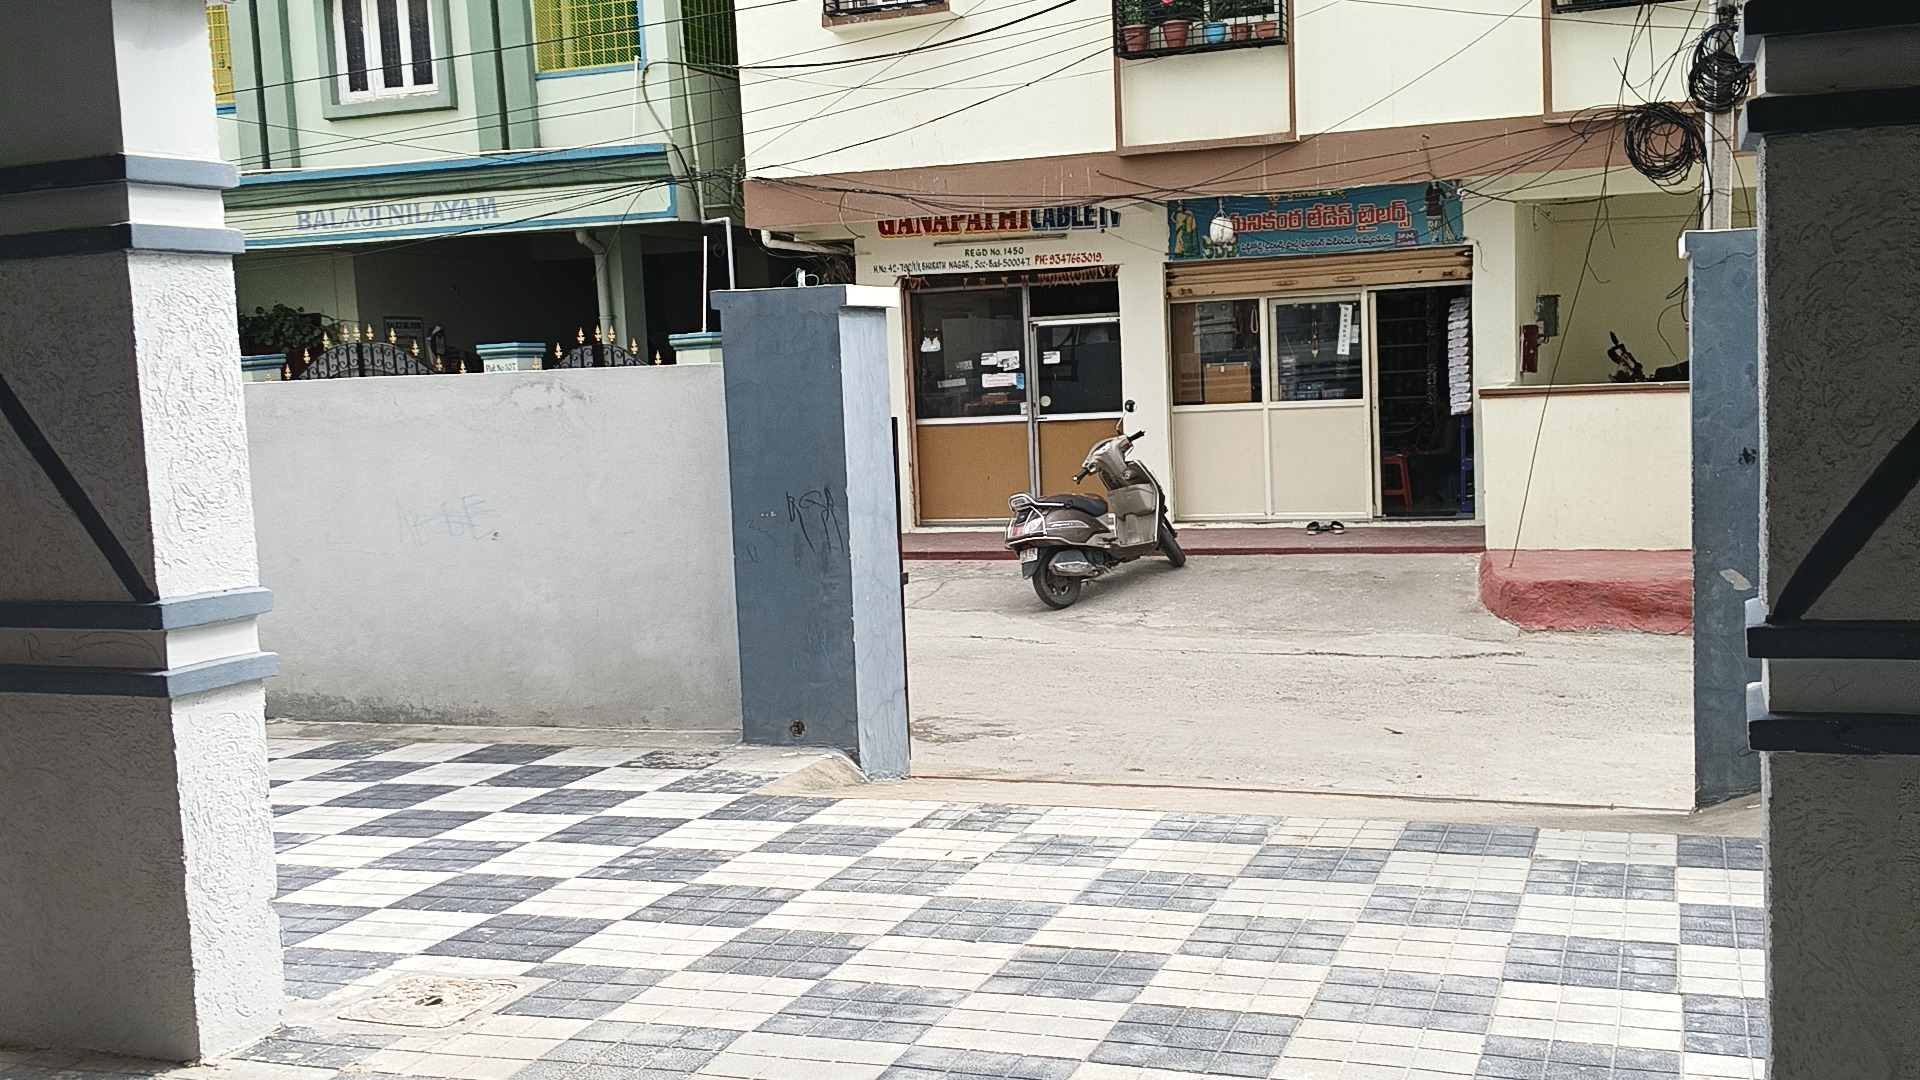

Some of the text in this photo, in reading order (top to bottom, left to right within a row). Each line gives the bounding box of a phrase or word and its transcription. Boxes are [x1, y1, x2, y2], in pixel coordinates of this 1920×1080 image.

[296, 197, 500, 230] BALAJI NILAYAM
[965, 248, 988, 257] REGD
[1003, 246, 1024, 255] 1450
